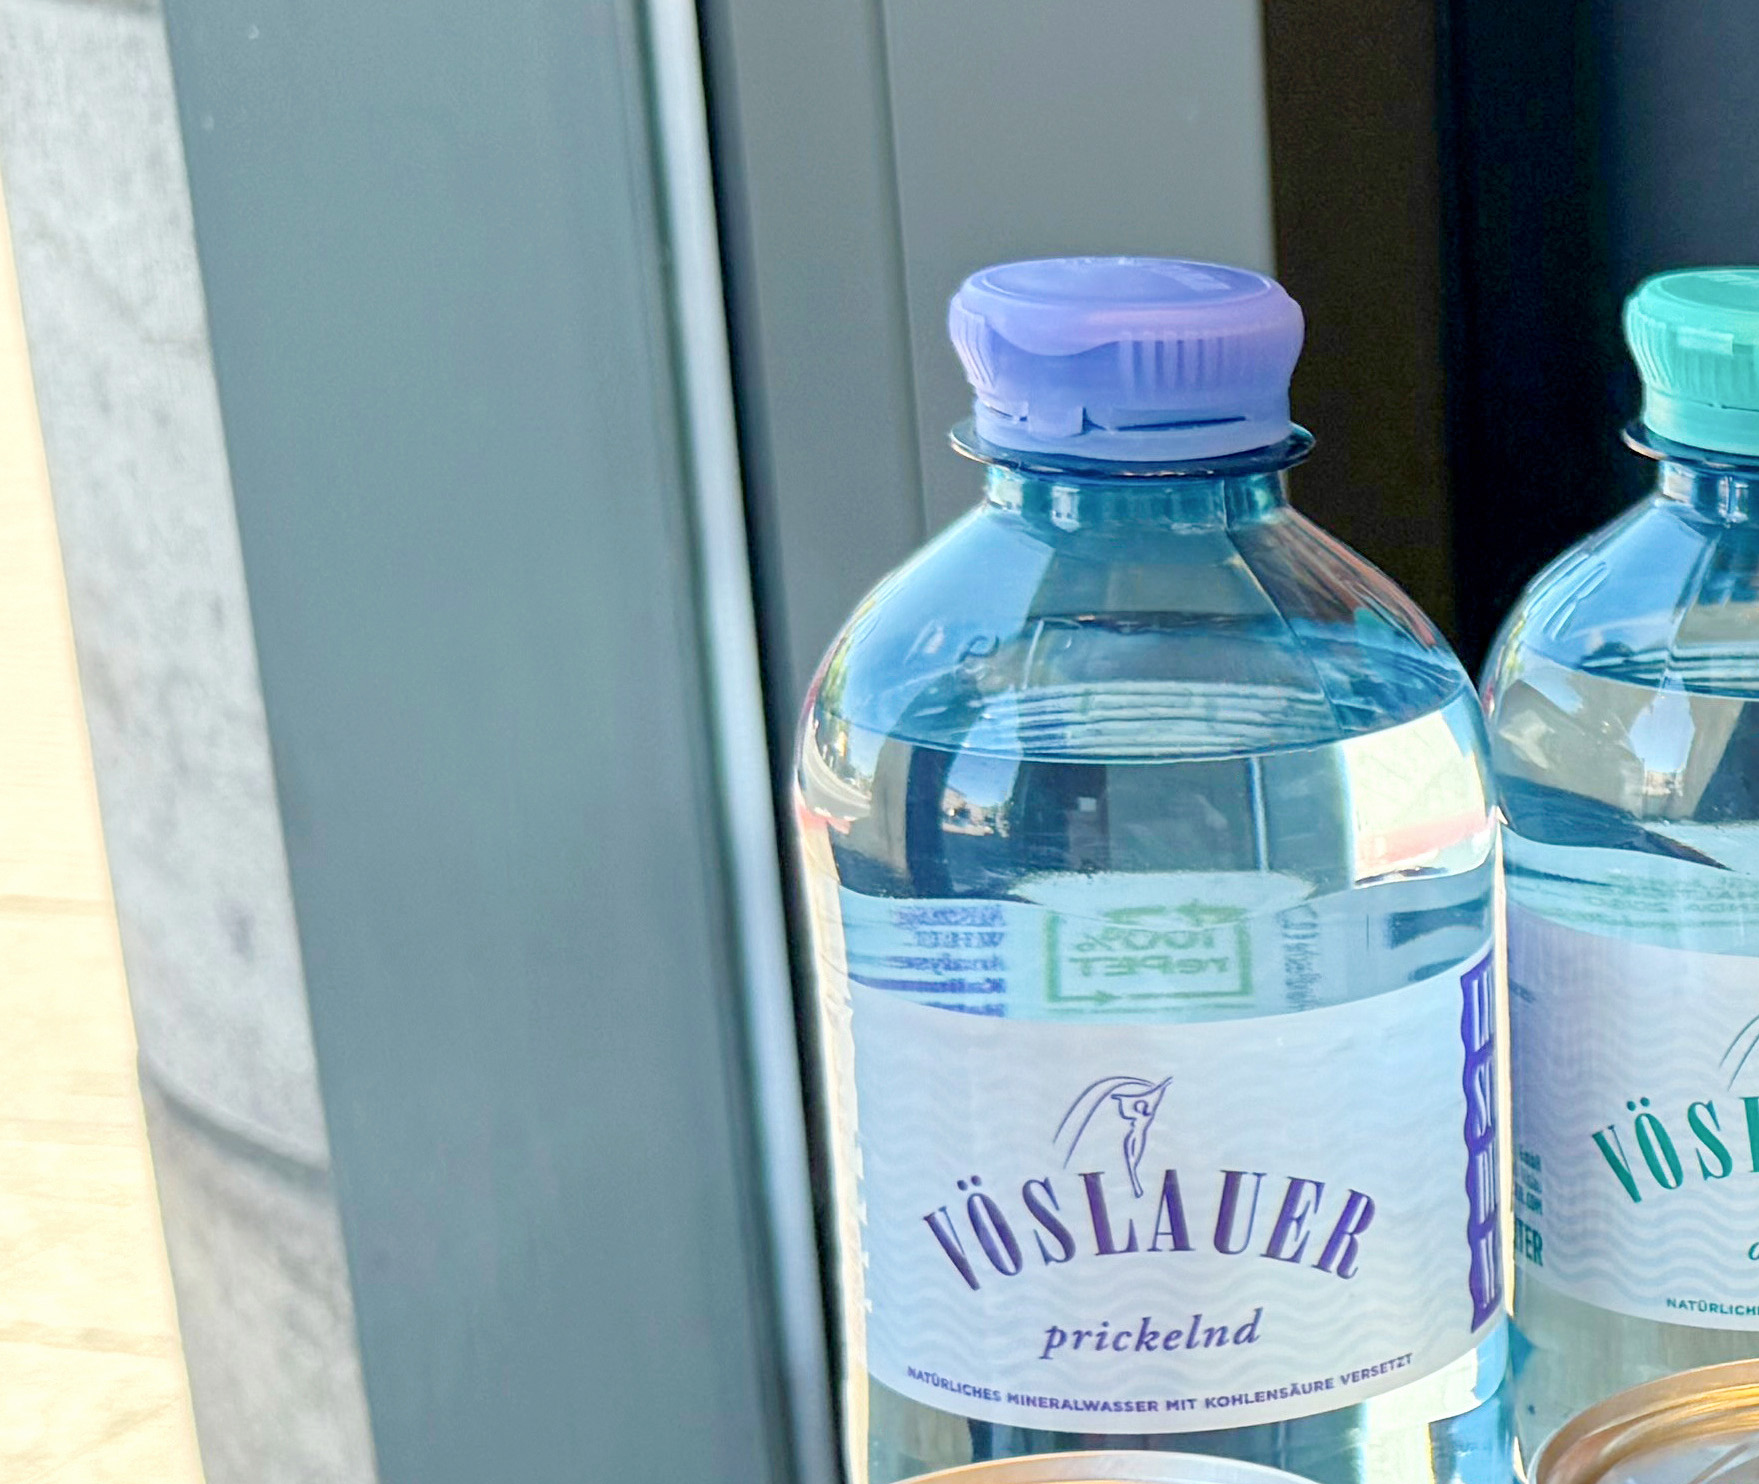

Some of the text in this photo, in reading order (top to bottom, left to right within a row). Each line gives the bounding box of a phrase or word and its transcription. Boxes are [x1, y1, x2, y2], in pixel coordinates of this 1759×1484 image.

[923, 1169, 1376, 1291] VÖSLAUER
[1040, 1308, 1265, 1360] prickelnd
[907, 1352, 1413, 1413] NATÜRLICHES MINERALWASSER MIT KOHLENSÄURE VERSETZT
